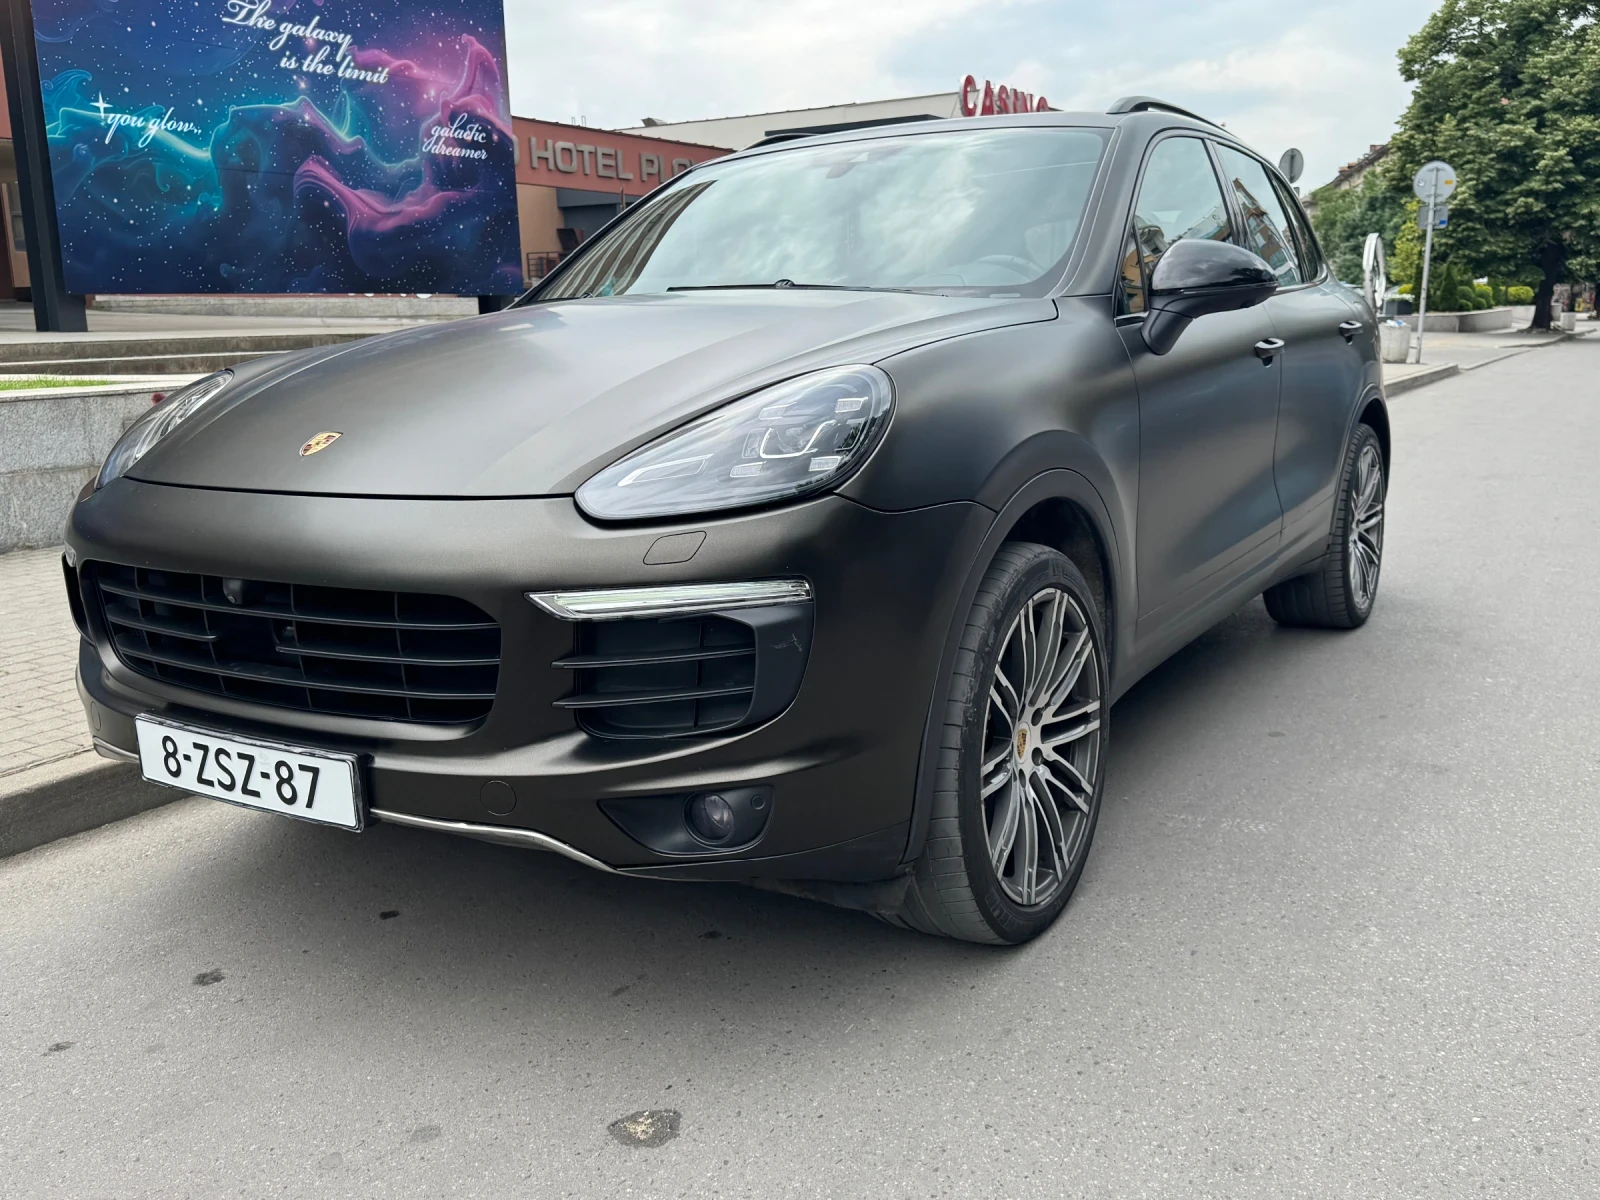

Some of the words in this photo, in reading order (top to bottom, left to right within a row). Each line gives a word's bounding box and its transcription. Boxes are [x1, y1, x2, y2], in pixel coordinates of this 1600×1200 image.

[222, 0, 276, 30] The
[269, 15, 353, 62] galaxy
[279, 51, 299, 69] is
[302, 45, 335, 75] the
[337, 55, 390, 84] limit
[106, 113, 146, 145] you
[422, 112, 487, 152] galactic
[430, 138, 489, 160] dreamer
[529, 136, 634, 181] HOTEL
[640, 152, 697, 184] PLO
[161, 735, 320, 809] 8-ZSZ-87
